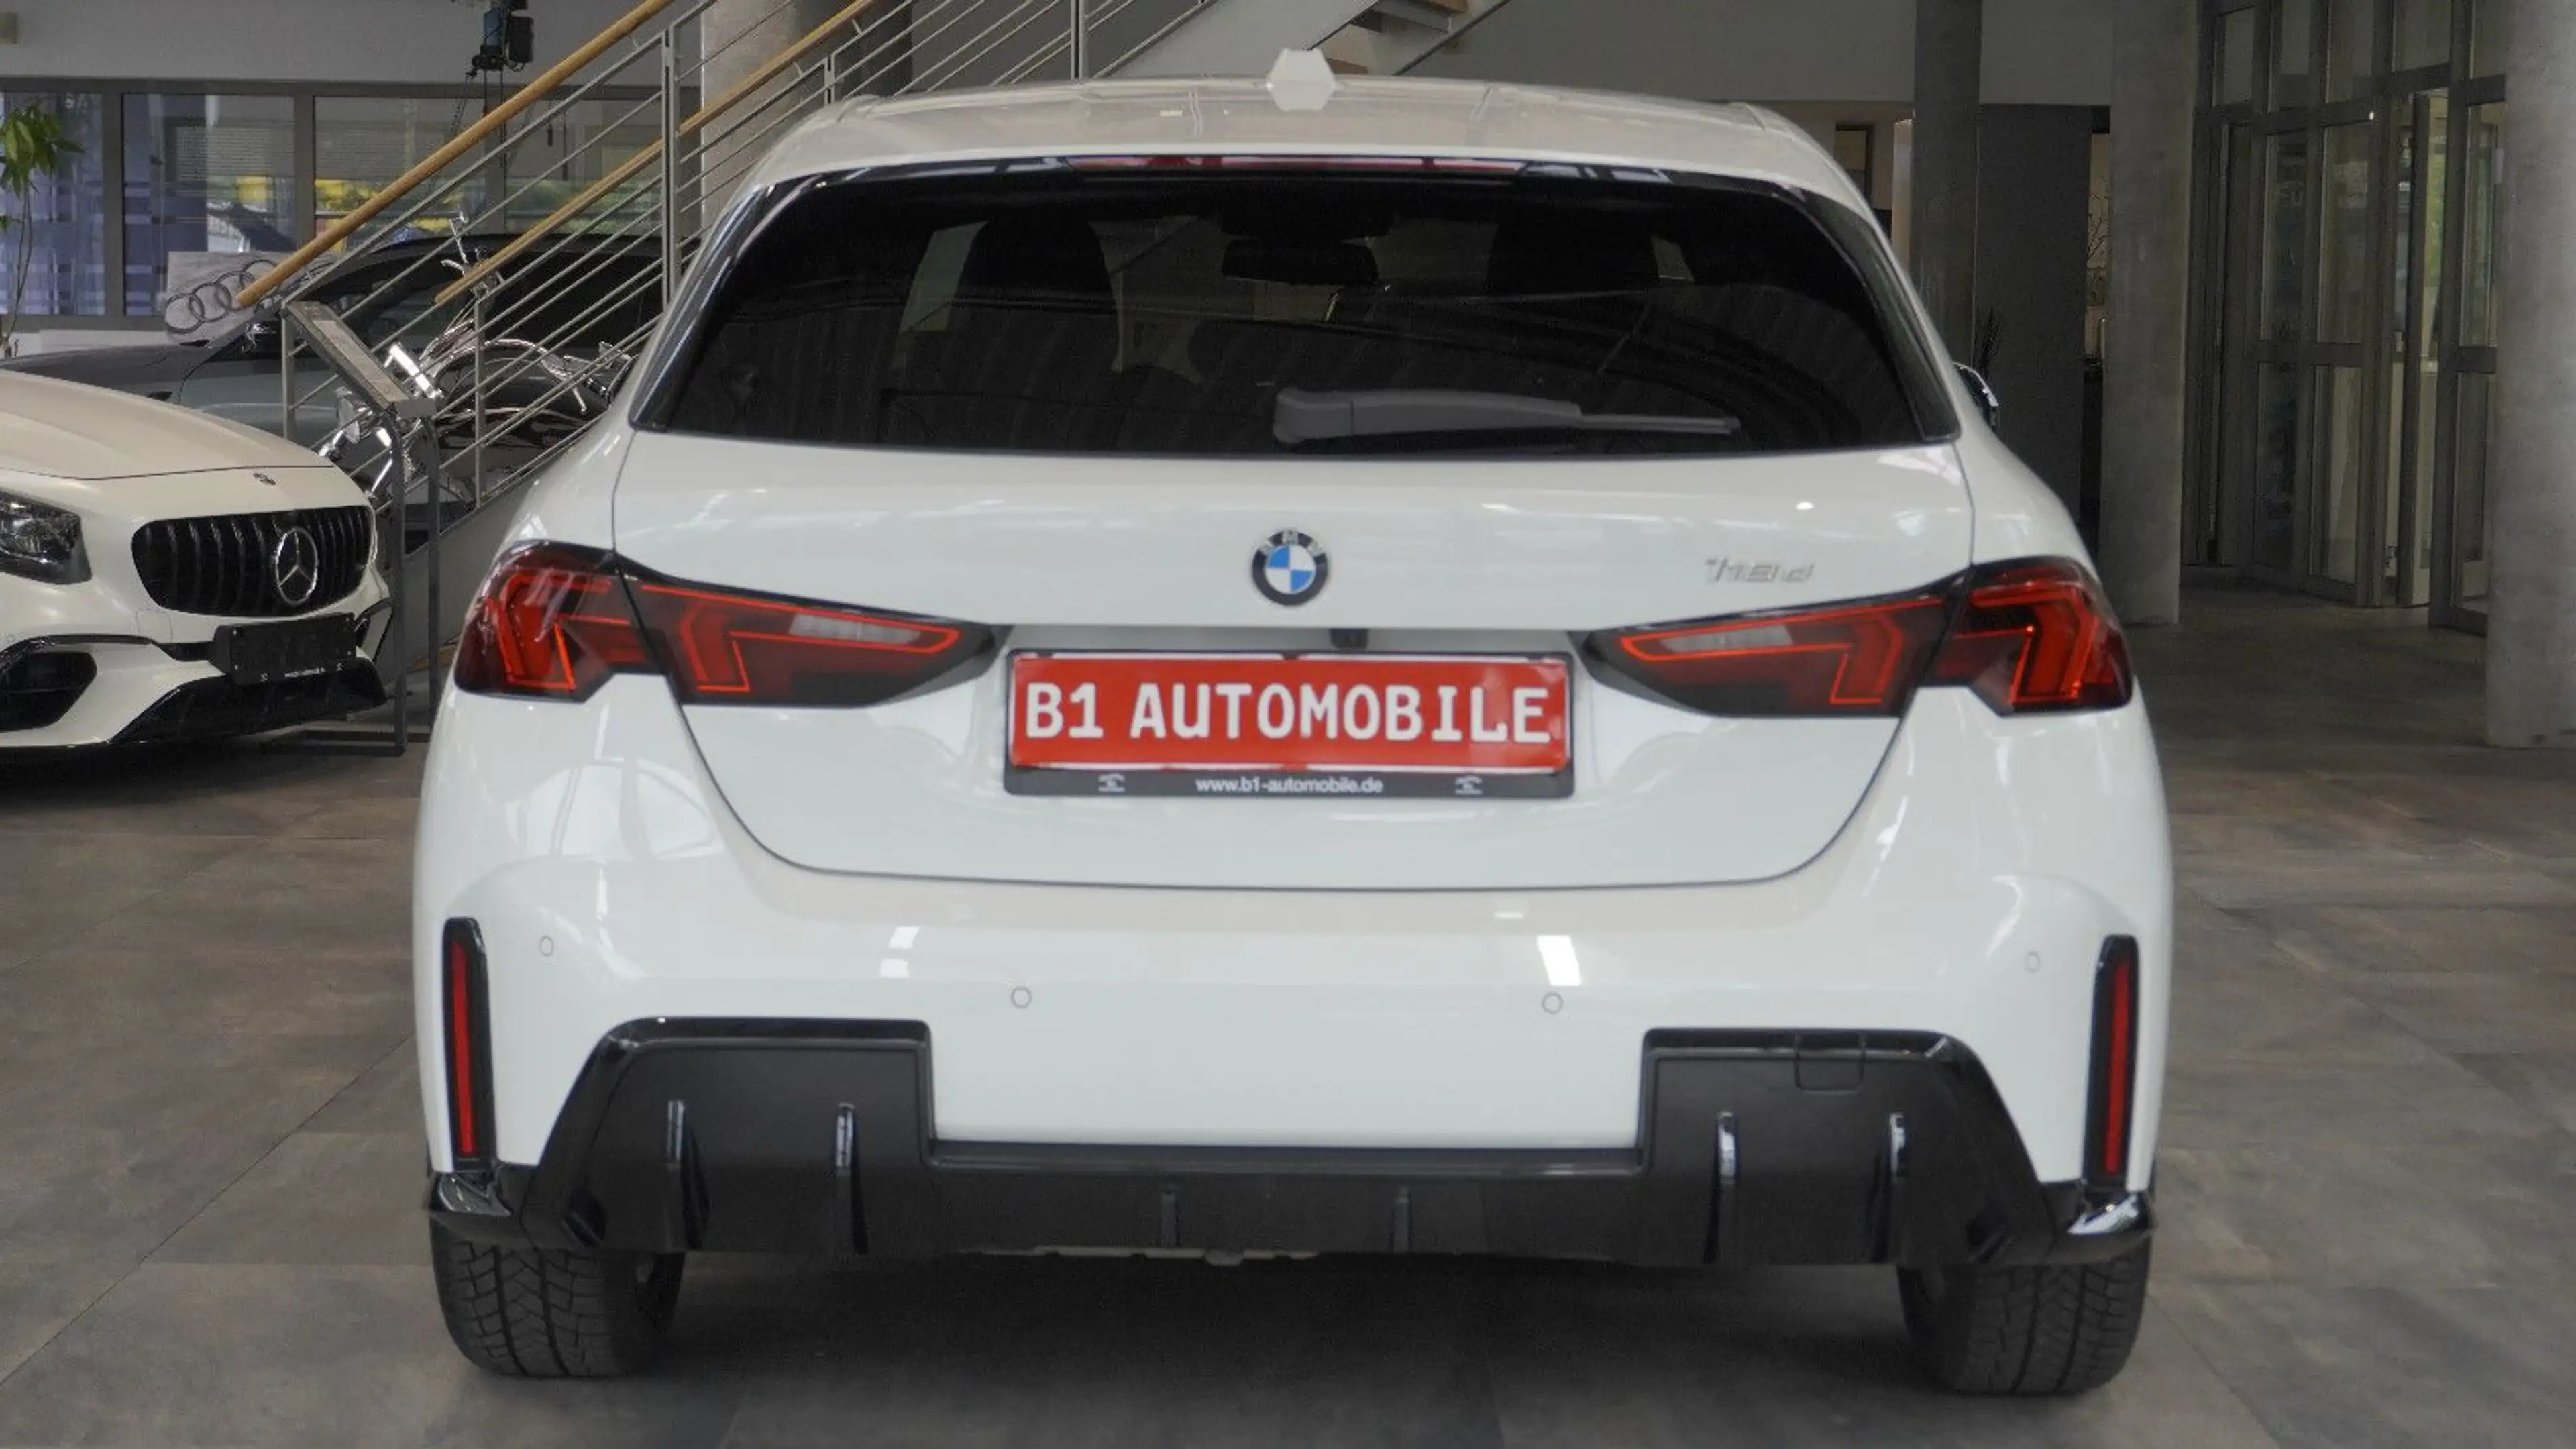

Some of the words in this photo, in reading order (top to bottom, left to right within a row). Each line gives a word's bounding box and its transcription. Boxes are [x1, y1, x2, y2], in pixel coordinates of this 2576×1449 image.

[1026, 682, 1104, 739] B1
[1130, 682, 1551, 743] AUTOMOBILE
[1195, 776, 1383, 793] www.b1-automobile.de
